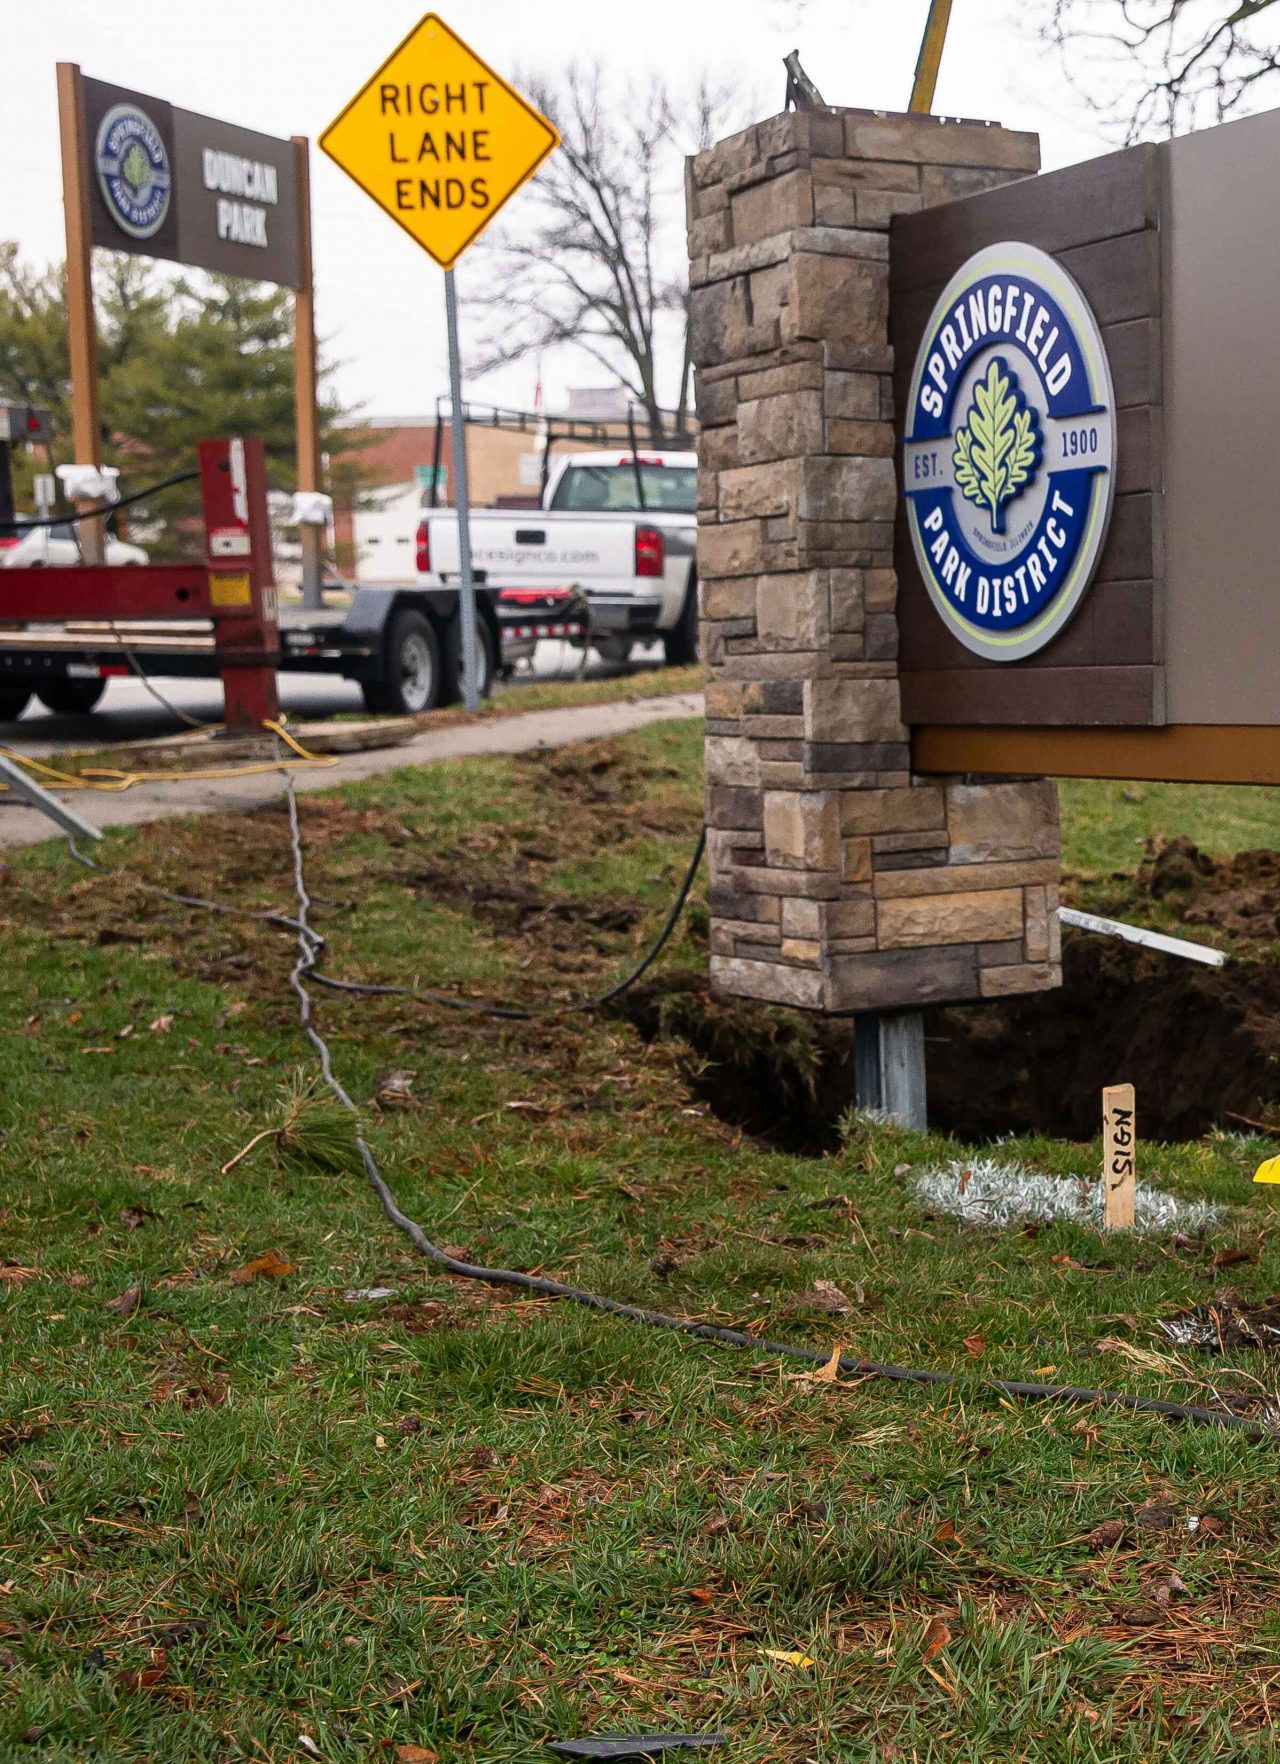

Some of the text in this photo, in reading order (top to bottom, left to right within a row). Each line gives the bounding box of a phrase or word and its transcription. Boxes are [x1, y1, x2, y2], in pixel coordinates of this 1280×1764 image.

[380, 83, 489, 115] RIGHT
[389, 130, 491, 163] LANE
[202, 148, 278, 205] DUNCAN
[396, 178, 490, 210] ENDS
[216, 198, 268, 248] PARK
[920, 284, 1072, 418] SPRINGFIELD
[914, 428, 1098, 479] EST. 1900
[923, 489, 1074, 617] PARK DISTRICT
[1111, 1107, 1134, 1176] SIGN
